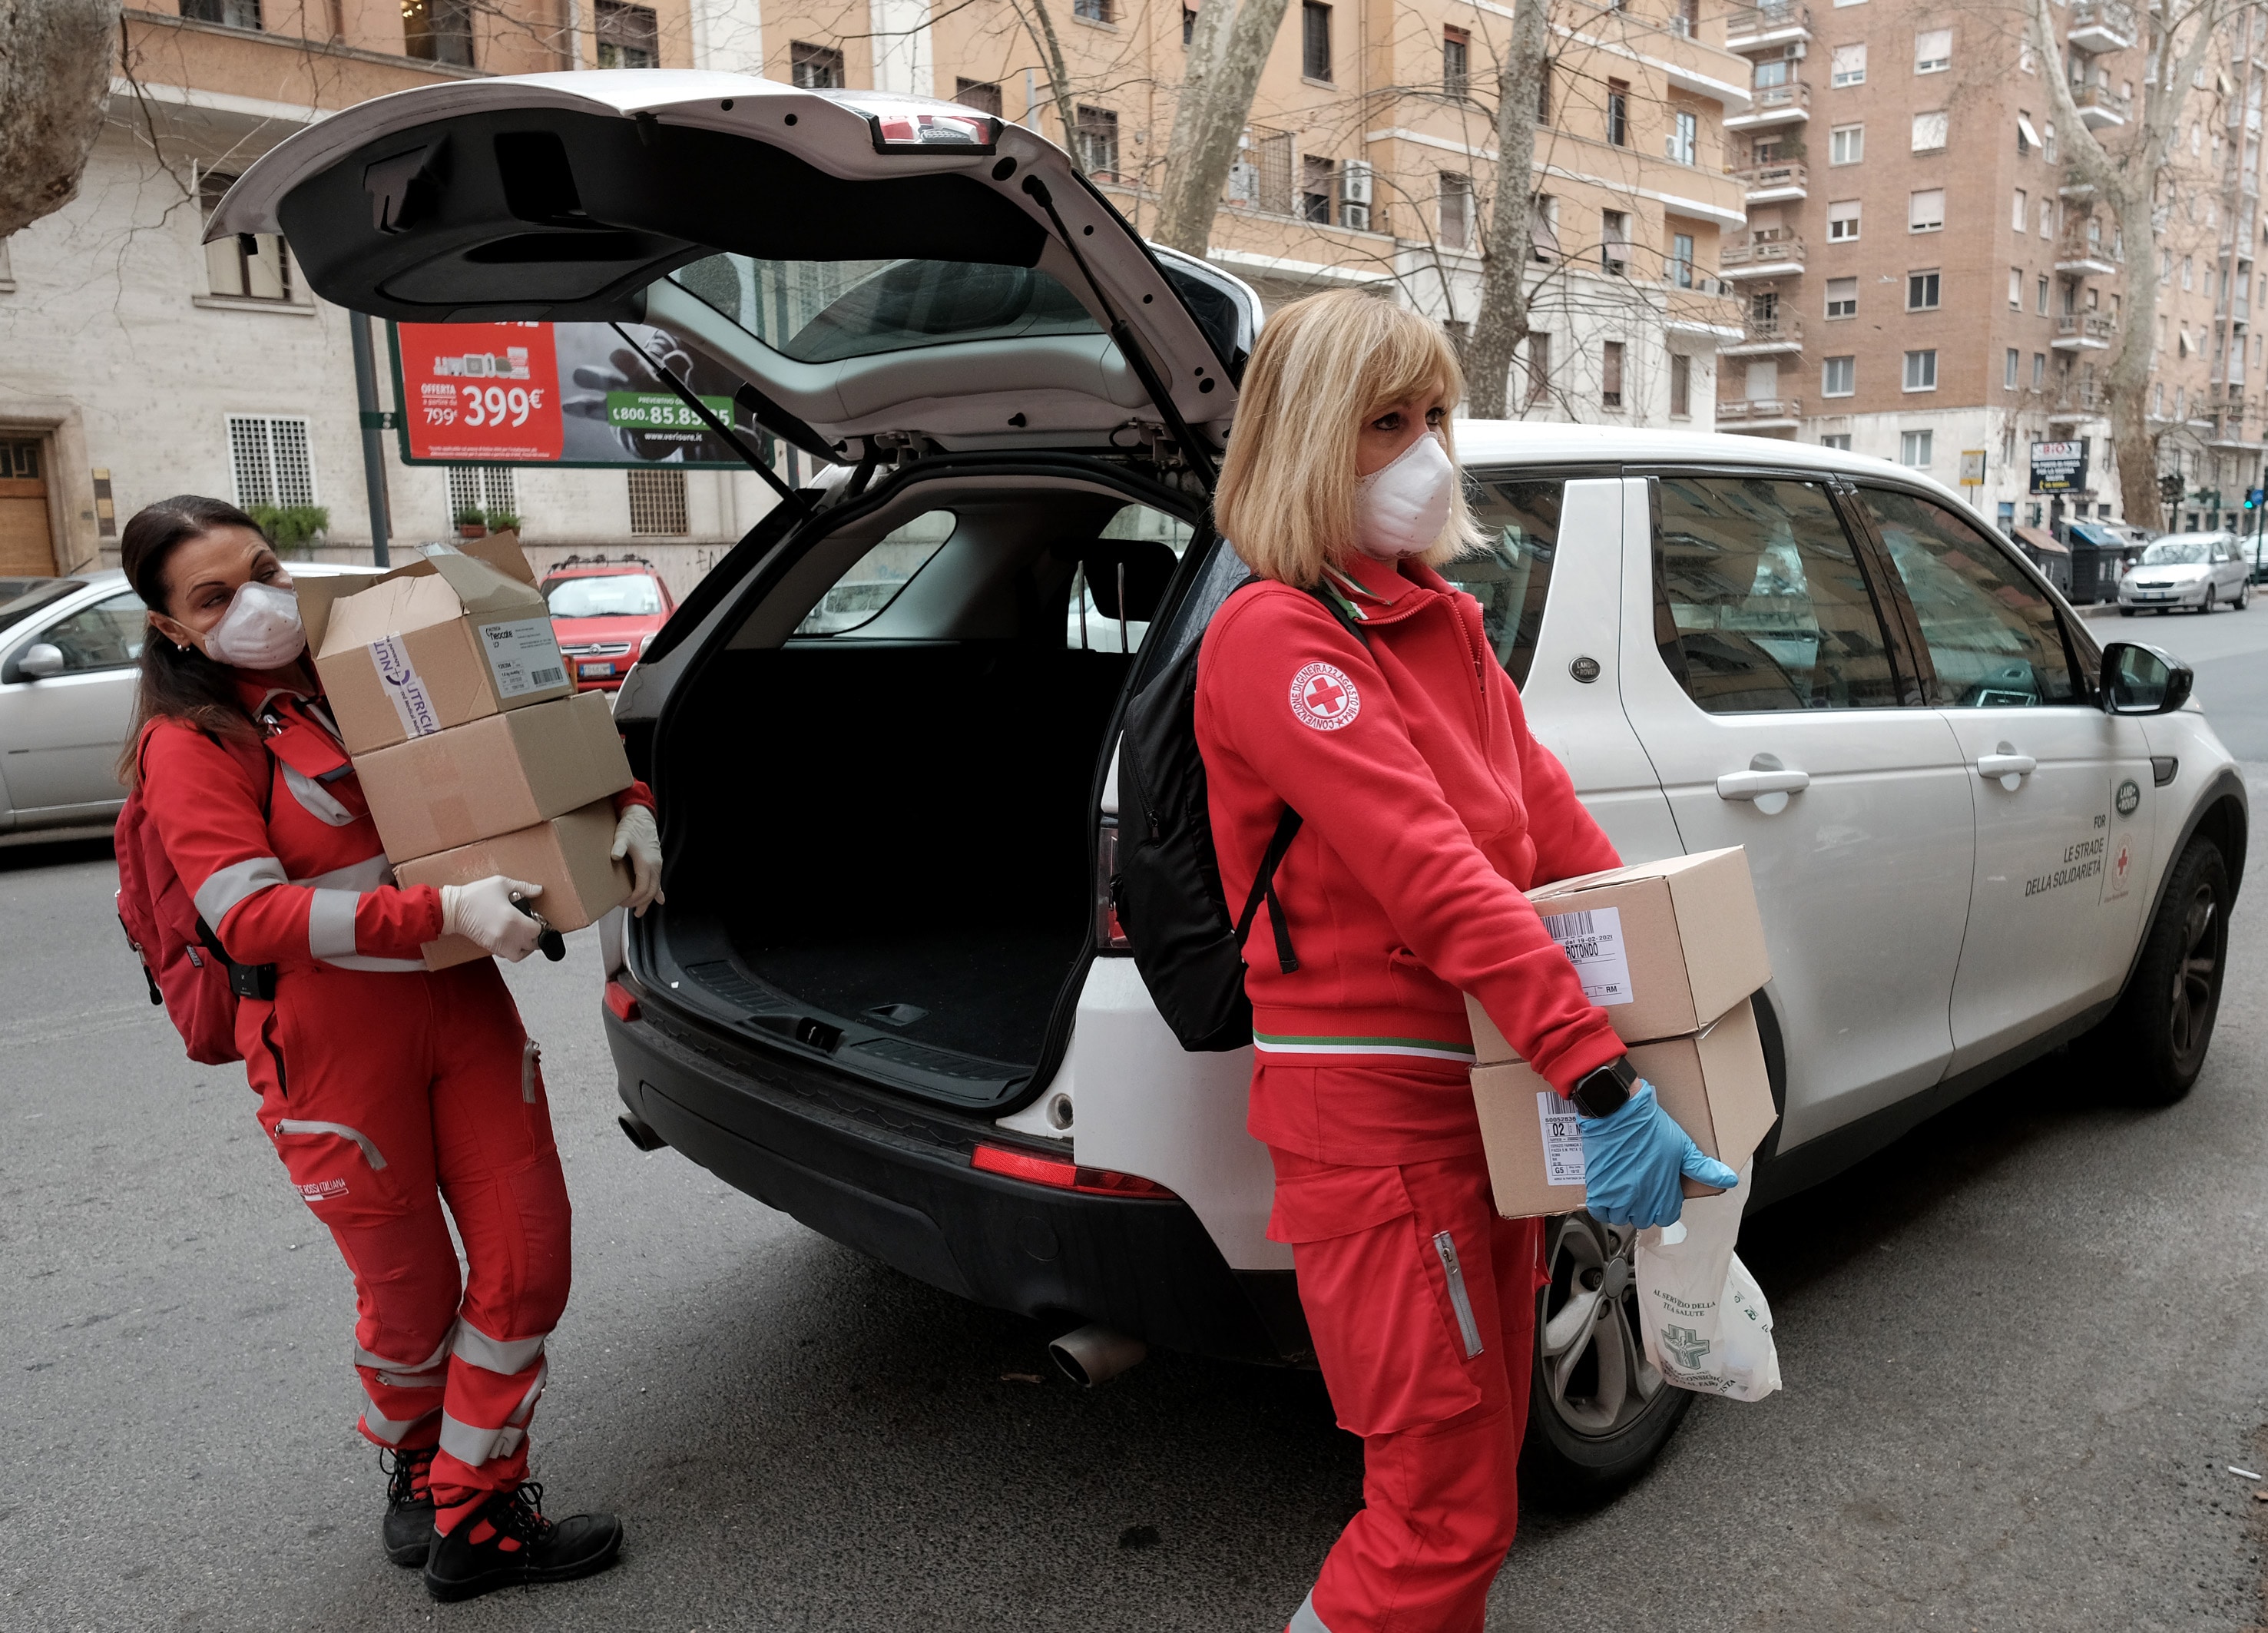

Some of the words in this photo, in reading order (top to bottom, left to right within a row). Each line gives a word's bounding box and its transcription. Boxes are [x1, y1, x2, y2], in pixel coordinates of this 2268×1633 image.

[421, 383, 456, 395] OFFERTA
[644, 432, 703, 442] www.verisure.it
[1296, 664, 1327, 684] GINEVRA
[1328, 666, 1338, 676] 22
[1292, 683, 1302, 692] DI
[1337, 673, 1359, 706] AGOSTO
[1292, 693, 1334, 729] CONVENZIONE
[1343, 706, 1359, 723] 1864
[2120, 784, 2133, 798] LAND
[2121, 796, 2137, 811] ROVER
[2094, 814, 2106, 829] FOR
[2064, 846, 2074, 863] LE
[2074, 838, 2104, 860] STRADE
[2025, 876, 2051, 897] DELLA
[2053, 856, 2101, 889] SOLIDARIETÀ
[1553, 1123, 1564, 1136] 02
[320, 1178, 346, 1193] ITALIANA
[1653, 1289, 1660, 1297] AL
[1662, 1292, 1690, 1309] SERVIZIO
[1691, 1301, 1716, 1310] DELLA
[1663, 1302, 1675, 1313] TUA
[1675, 1308, 1705, 1317] SALUTE
